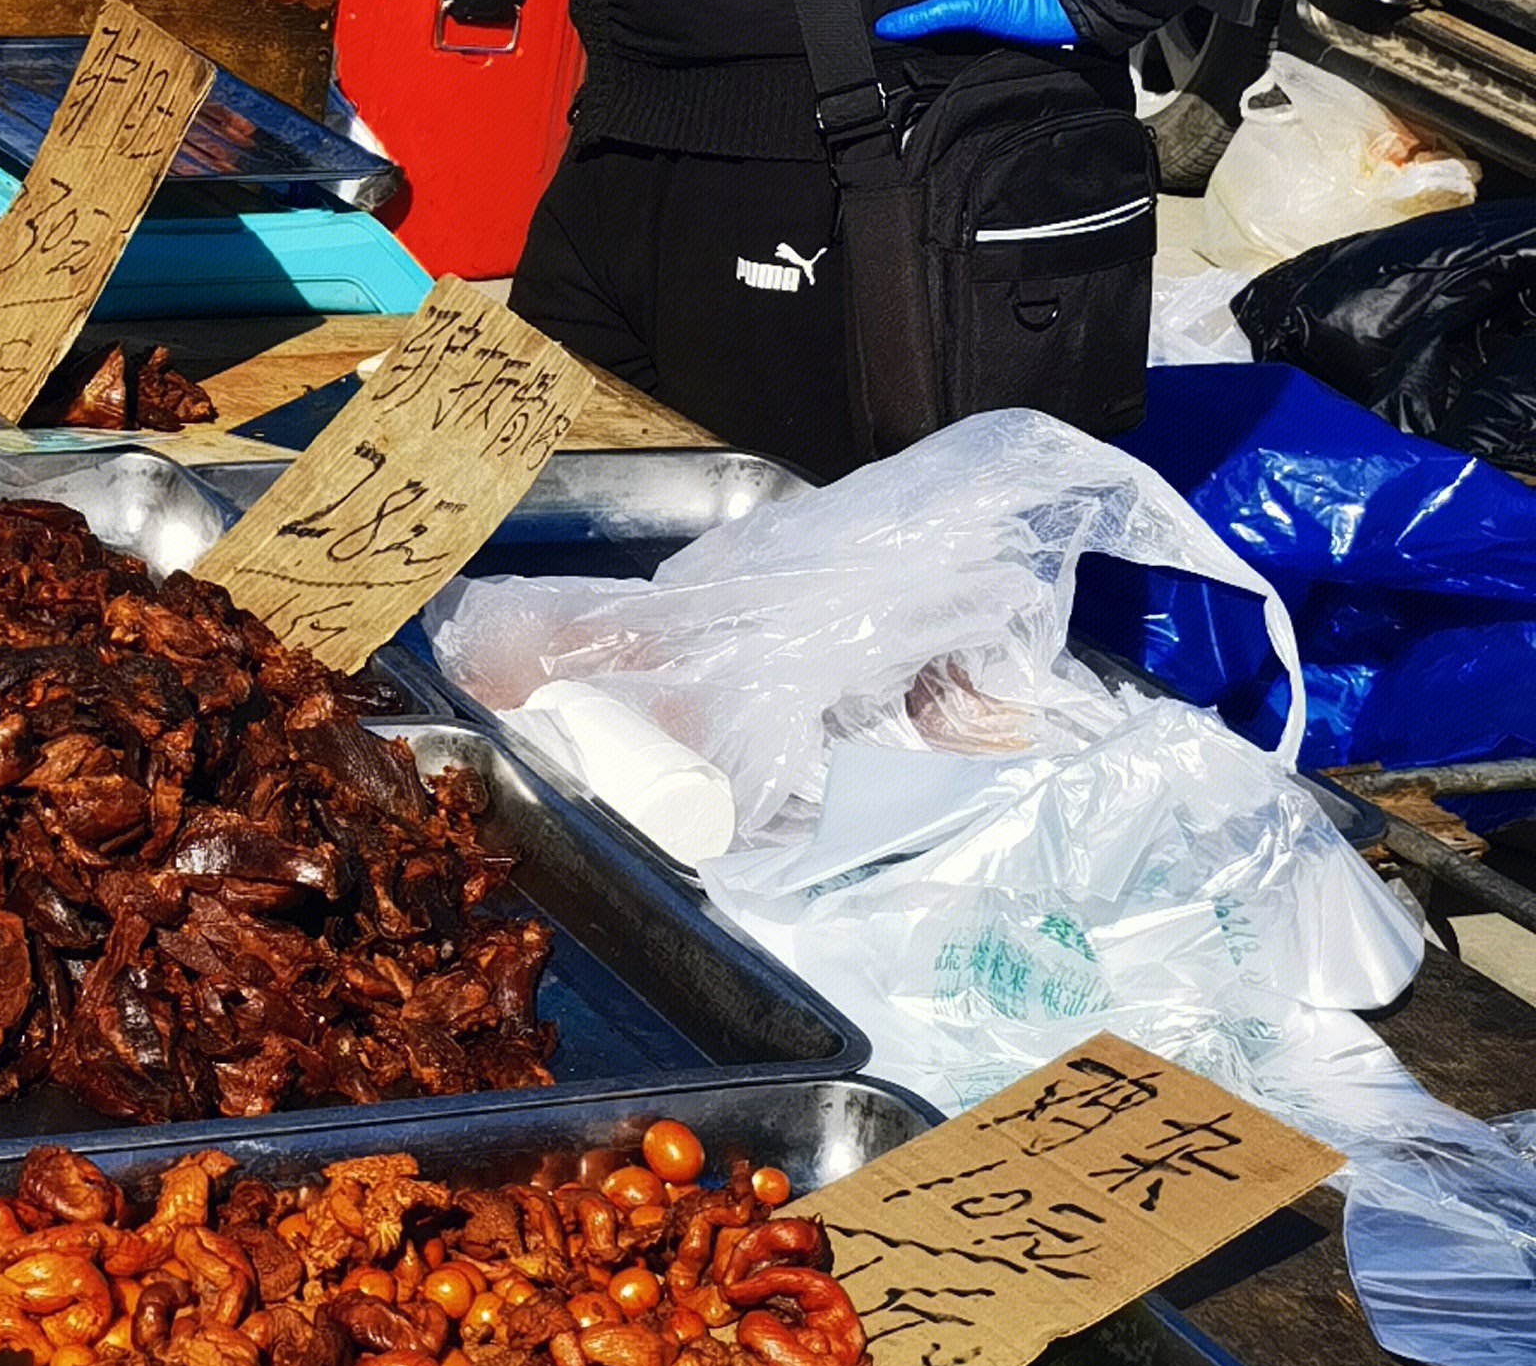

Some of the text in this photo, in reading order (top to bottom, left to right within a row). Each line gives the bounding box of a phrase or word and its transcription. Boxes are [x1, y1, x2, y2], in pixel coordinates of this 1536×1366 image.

[59, 27, 175, 162] 驴肚
[736, 256, 801, 292] PUMA
[275, 441, 468, 567] 28元
[977, 1057, 1243, 1212] 鸡杂
[881, 1160, 1107, 1262] 10元
